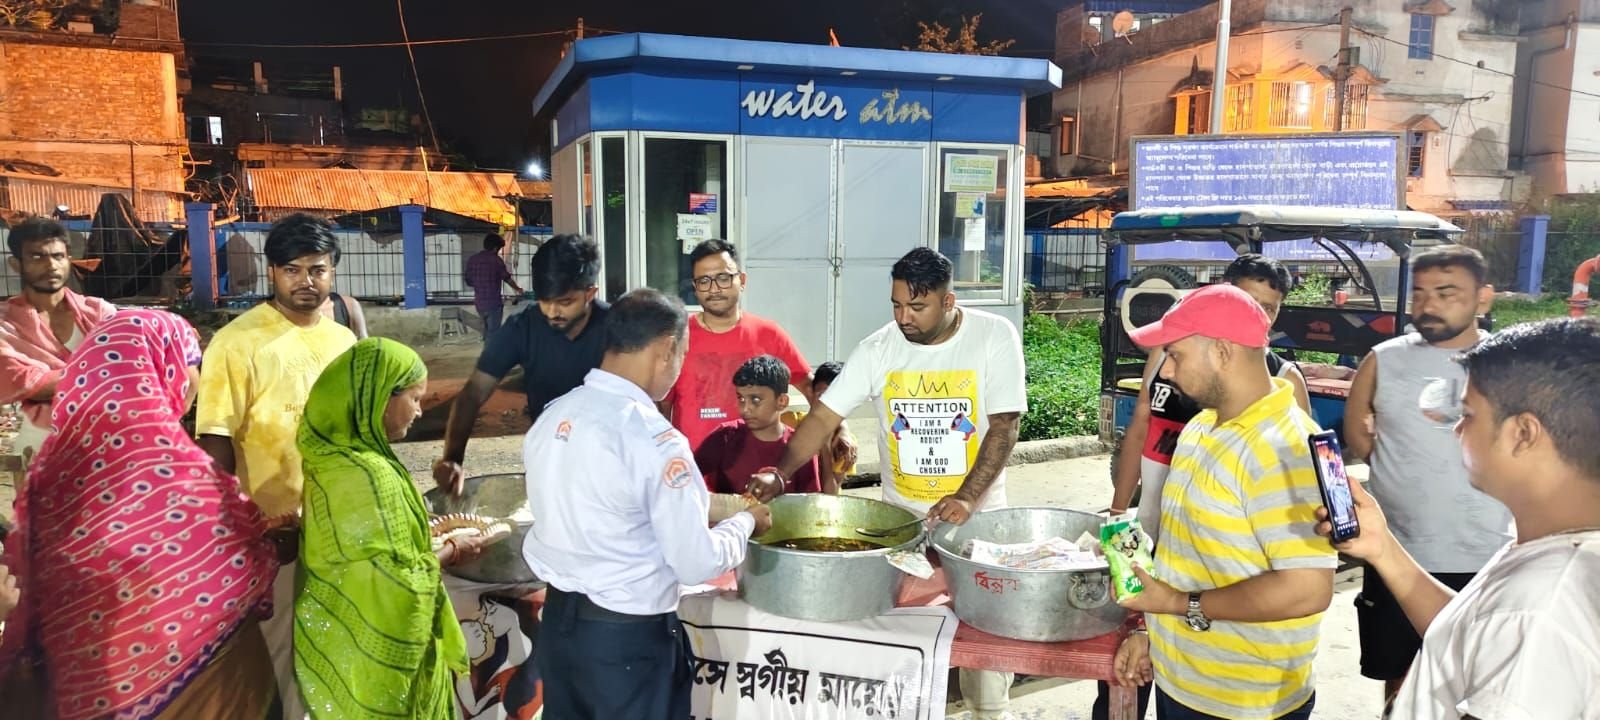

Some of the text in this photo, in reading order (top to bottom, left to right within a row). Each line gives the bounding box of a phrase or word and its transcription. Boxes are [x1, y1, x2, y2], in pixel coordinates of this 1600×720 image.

[742, 80, 932, 125] water atm
[894, 402, 968, 413] ATTENTION
[1151, 384, 1172, 410] 18
[928, 447, 934, 456] &
[694, 656, 730, 693] সে
